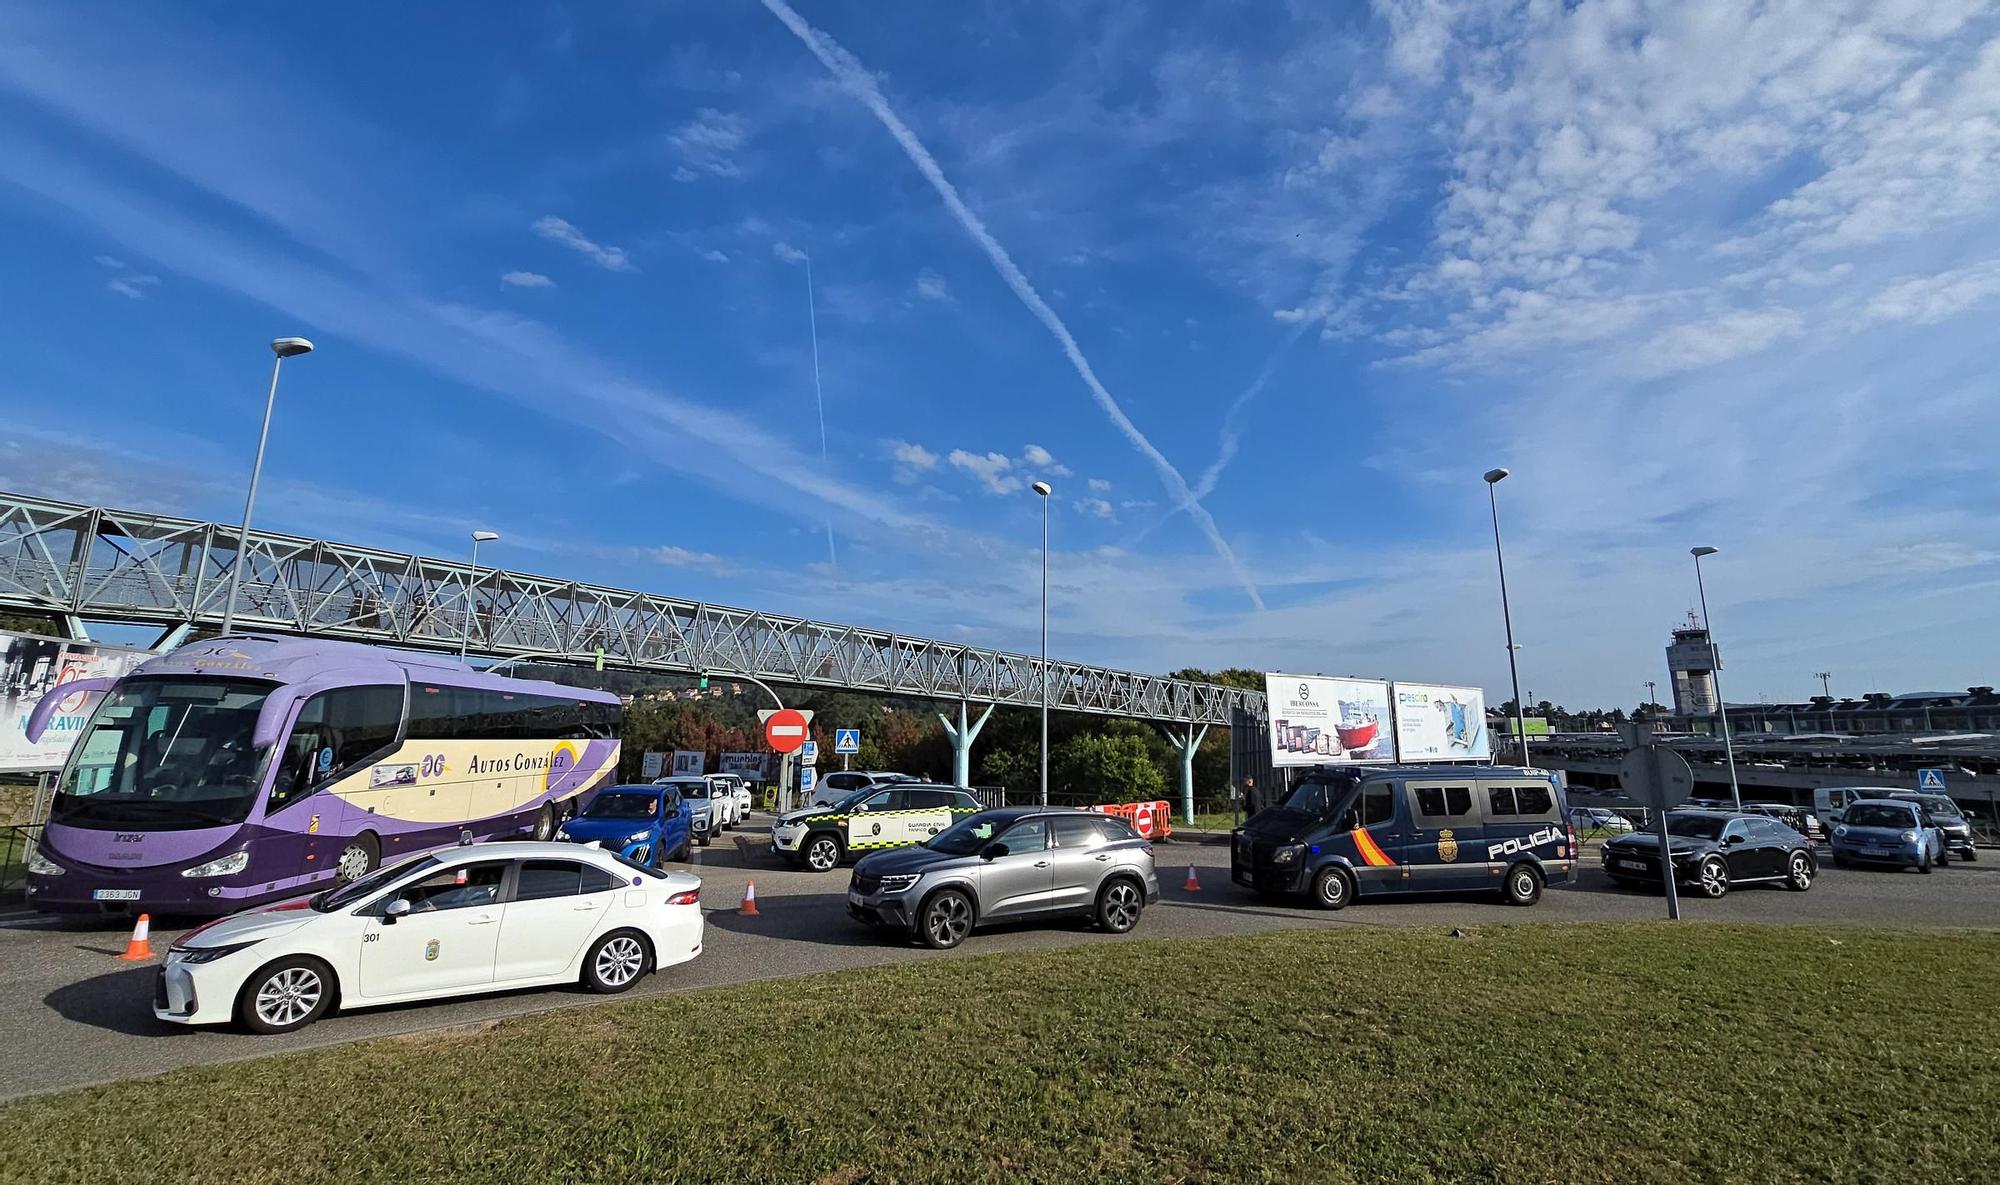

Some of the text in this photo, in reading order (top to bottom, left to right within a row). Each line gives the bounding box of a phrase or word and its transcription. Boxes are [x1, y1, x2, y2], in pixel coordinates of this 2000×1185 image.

[468, 755, 510, 775] AUTOS
[514, 751, 564, 771] GONZÁLEZ
[725, 754, 762, 764] muebles
[1488, 826, 1567, 860] POLICÍA
[363, 933, 380, 943] 301
